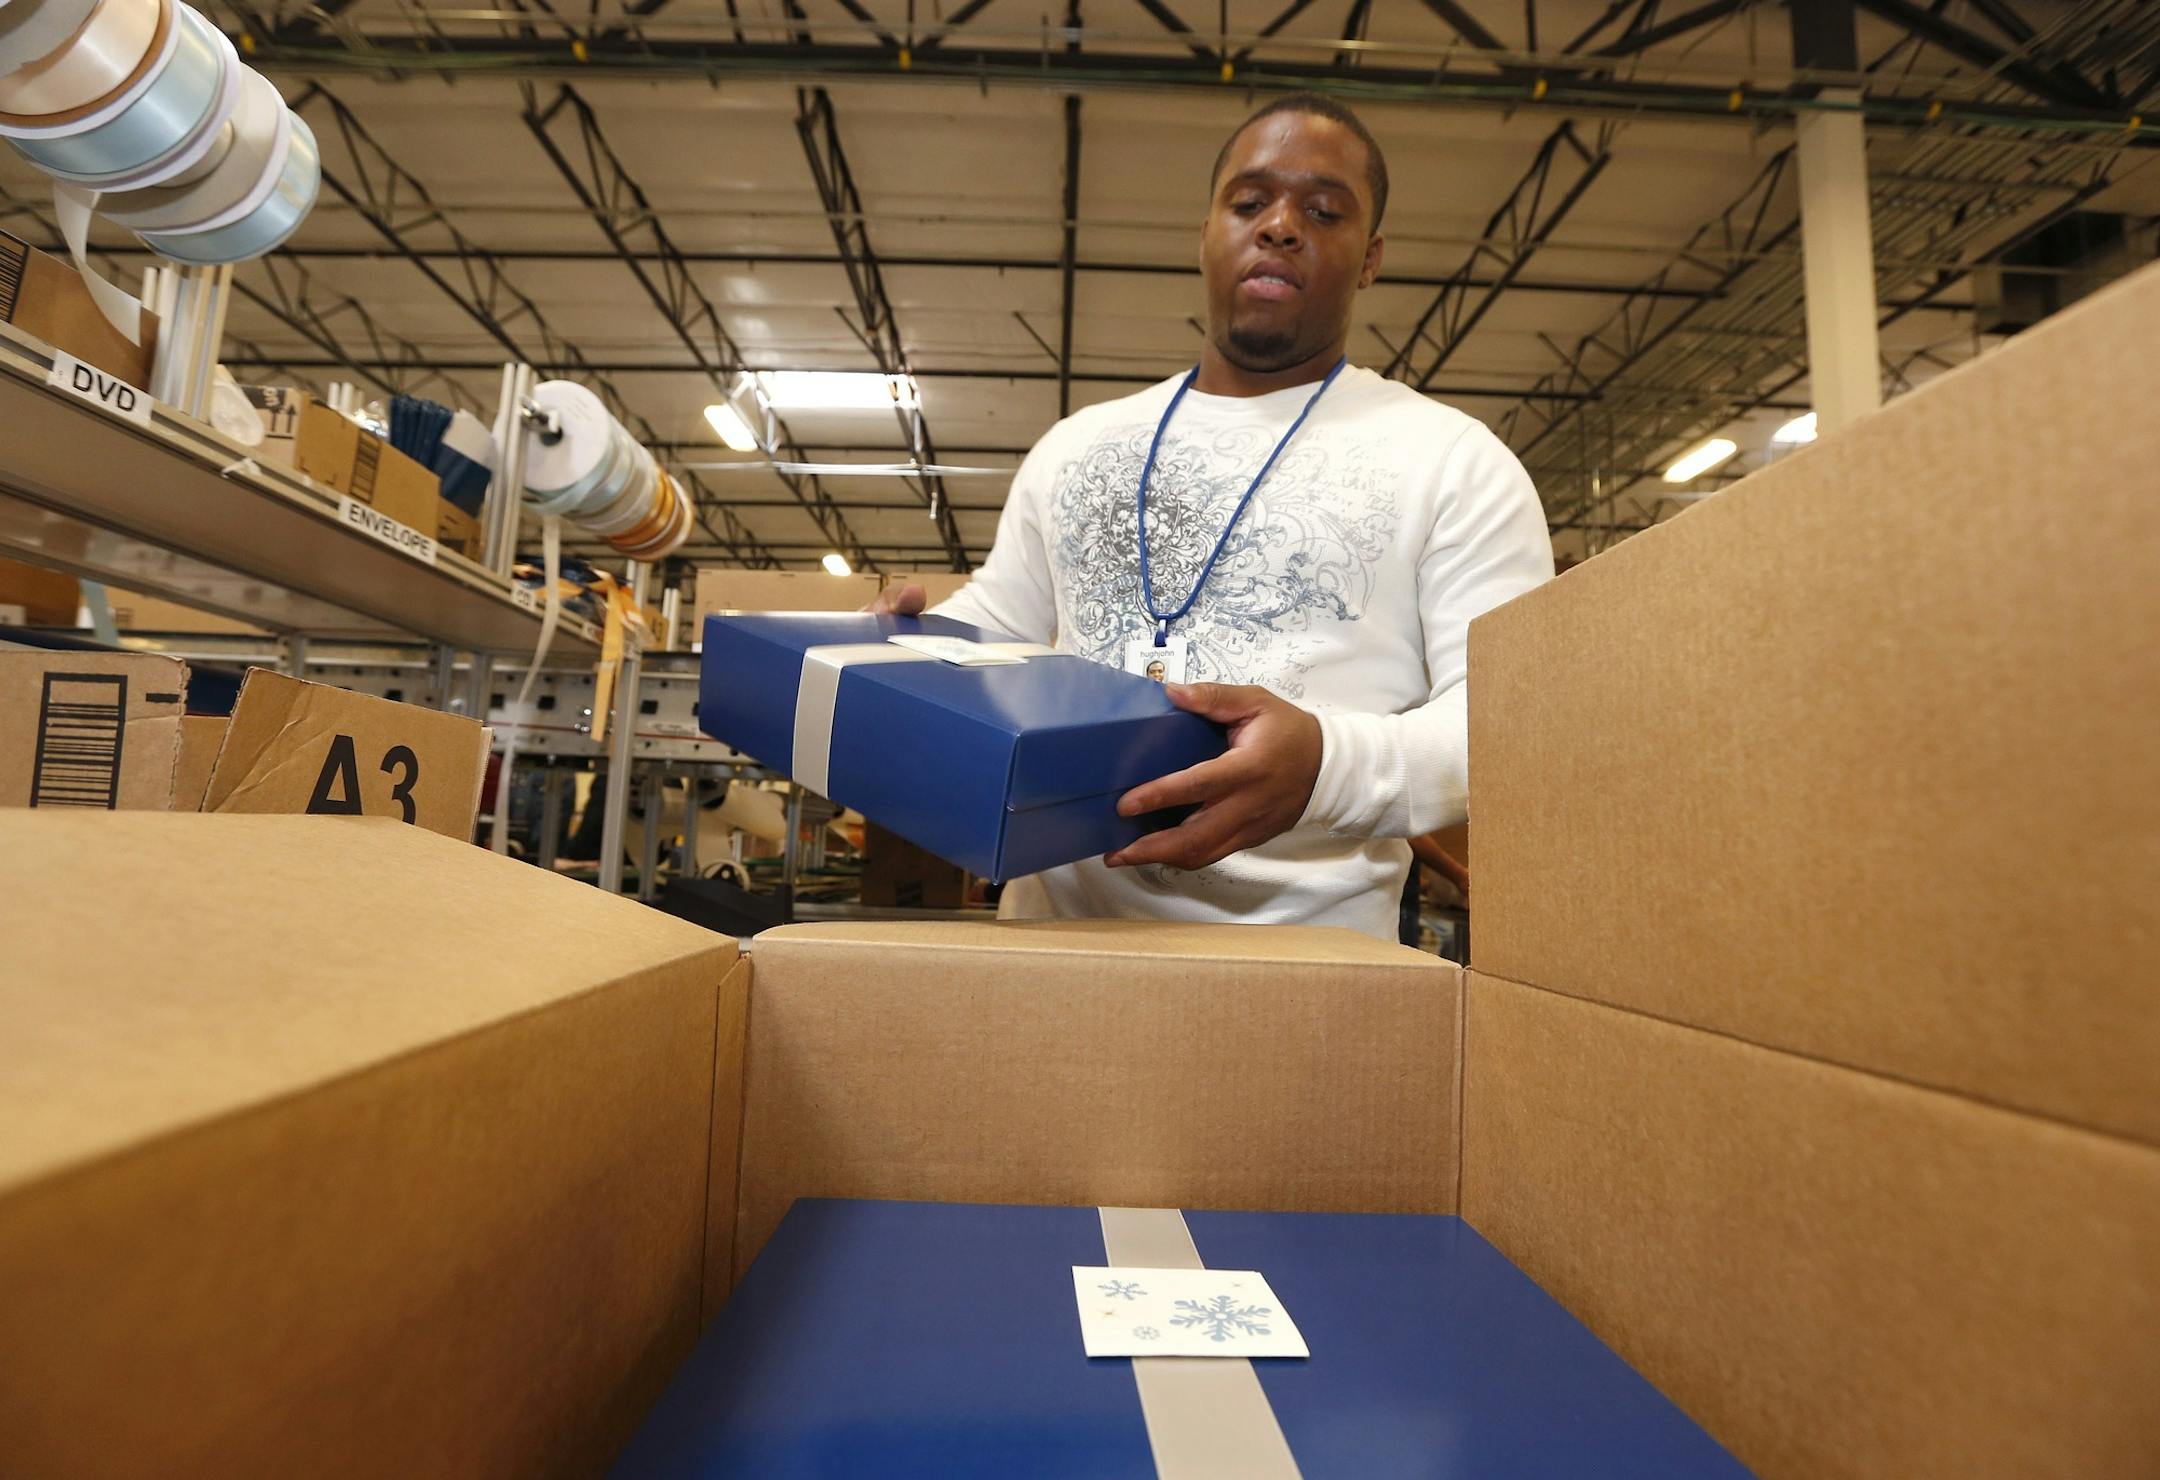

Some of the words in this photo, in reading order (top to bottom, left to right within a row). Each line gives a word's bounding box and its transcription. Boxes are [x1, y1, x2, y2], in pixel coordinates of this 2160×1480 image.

[73, 363, 135, 411] DVD
[349, 503, 430, 556] ENVELOPE
[305, 734, 419, 826] A3
